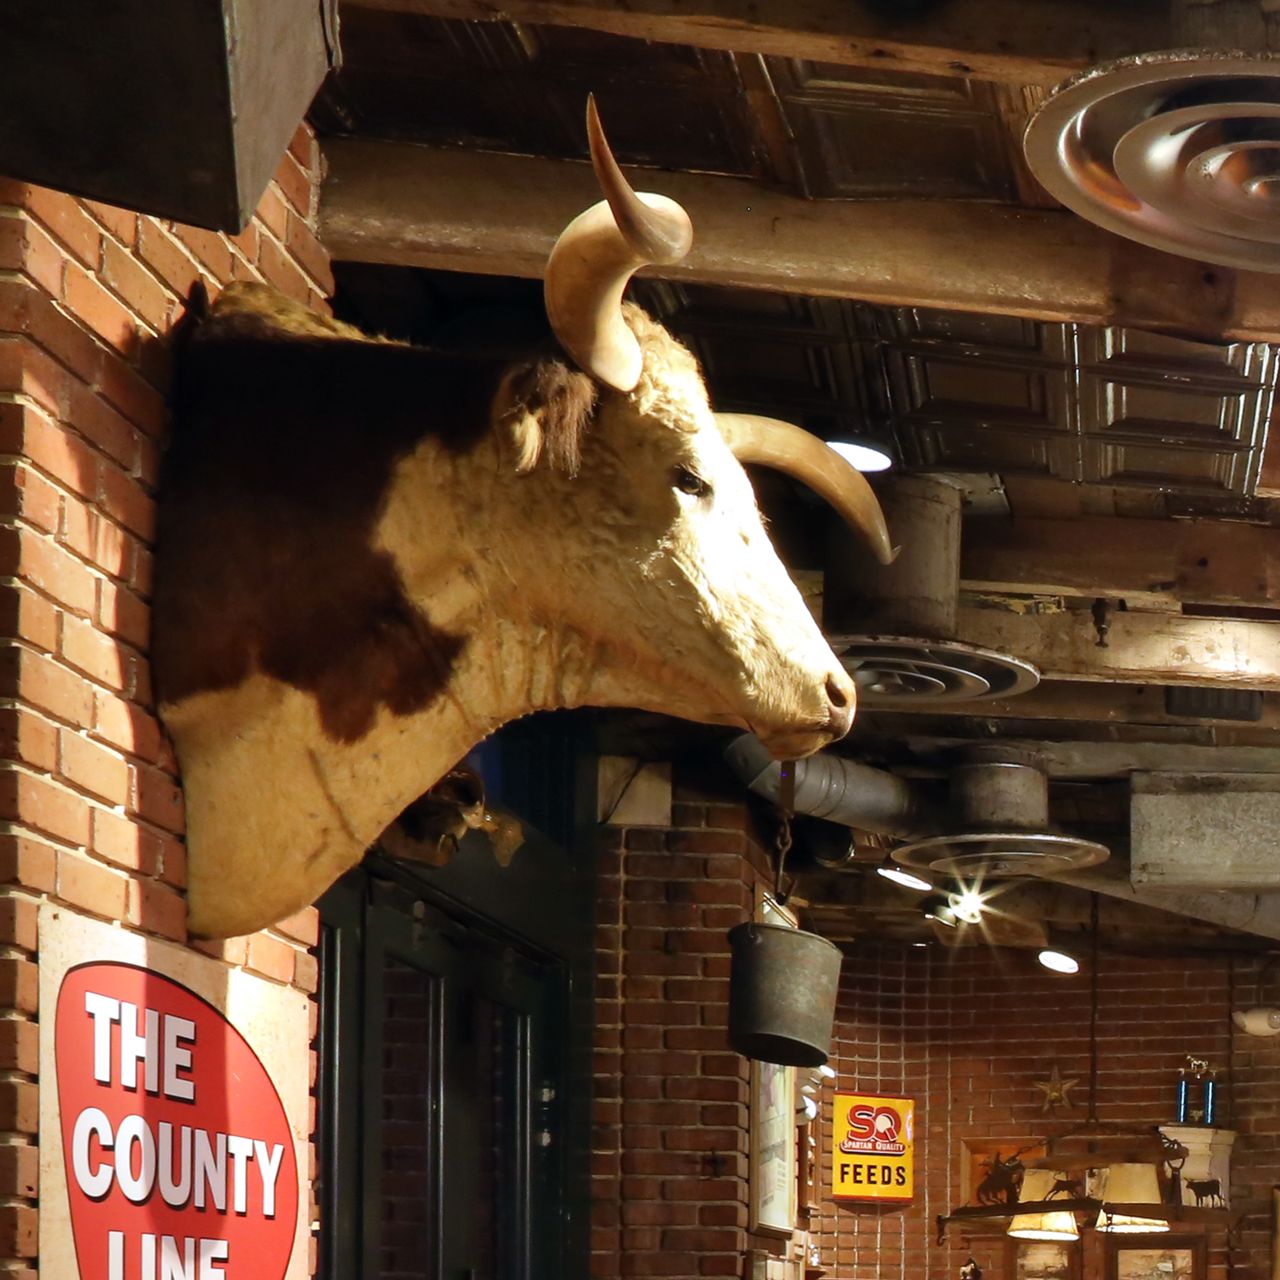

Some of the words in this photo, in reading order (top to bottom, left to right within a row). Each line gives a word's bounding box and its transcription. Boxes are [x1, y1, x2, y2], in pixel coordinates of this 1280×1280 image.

[85, 990, 196, 1102] THE
[847, 1104, 902, 1142] SQ
[72, 1107, 285, 1218] COUNTY
[840, 1163, 906, 1187] FEEDS
